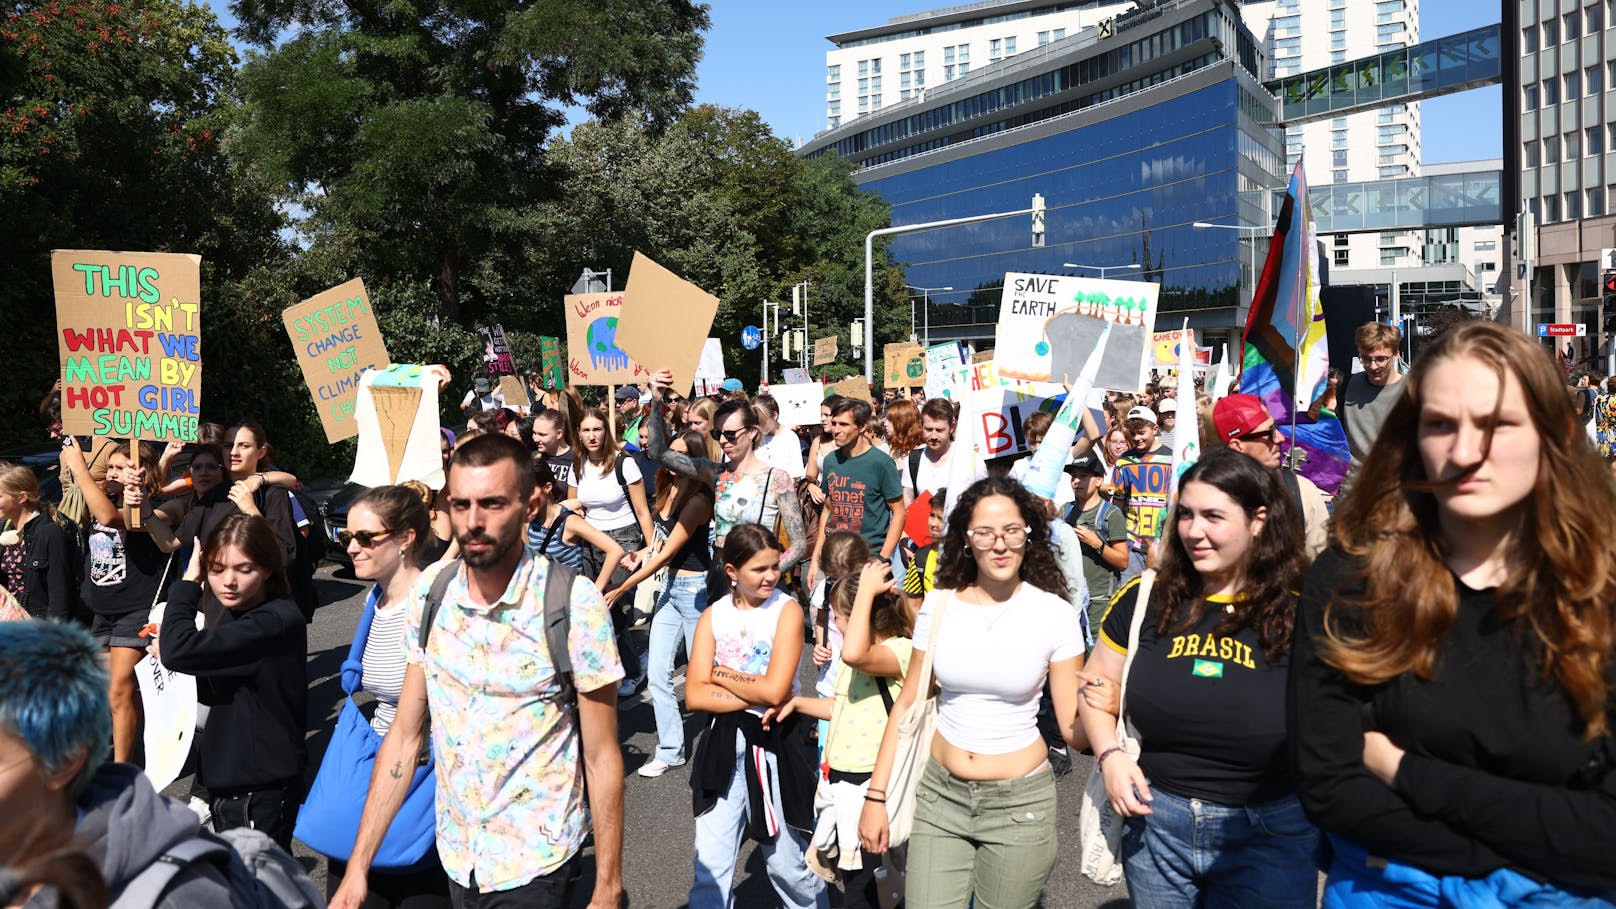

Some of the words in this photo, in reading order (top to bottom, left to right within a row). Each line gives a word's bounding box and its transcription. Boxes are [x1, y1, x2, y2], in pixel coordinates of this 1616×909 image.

[73, 263, 160, 304] THIS
[1014, 277, 1060, 295] SAVE
[125, 297, 198, 332] ISN'T
[293, 295, 367, 341] SYSTEM
[575, 300, 600, 318] Wenn
[1012, 299, 1057, 317] EARTH
[63, 328, 154, 354] WHAT
[158, 332, 200, 361] WE
[306, 324, 362, 358] CHANGE
[1153, 333, 1171, 342] GAME
[1550, 326, 1574, 334] Stadtpark
[65, 355, 151, 384] MEAN
[159, 357, 196, 388] BY
[327, 345, 358, 374] NOT
[66, 385, 125, 410] HOT
[138, 384, 199, 414] GIRL
[92, 408, 199, 442] SUMMER
[827, 472, 850, 487] Our
[1167, 633, 1256, 669] BRASIL
[150, 656, 164, 696] OVER
[1085, 842, 1104, 879] BISTR
